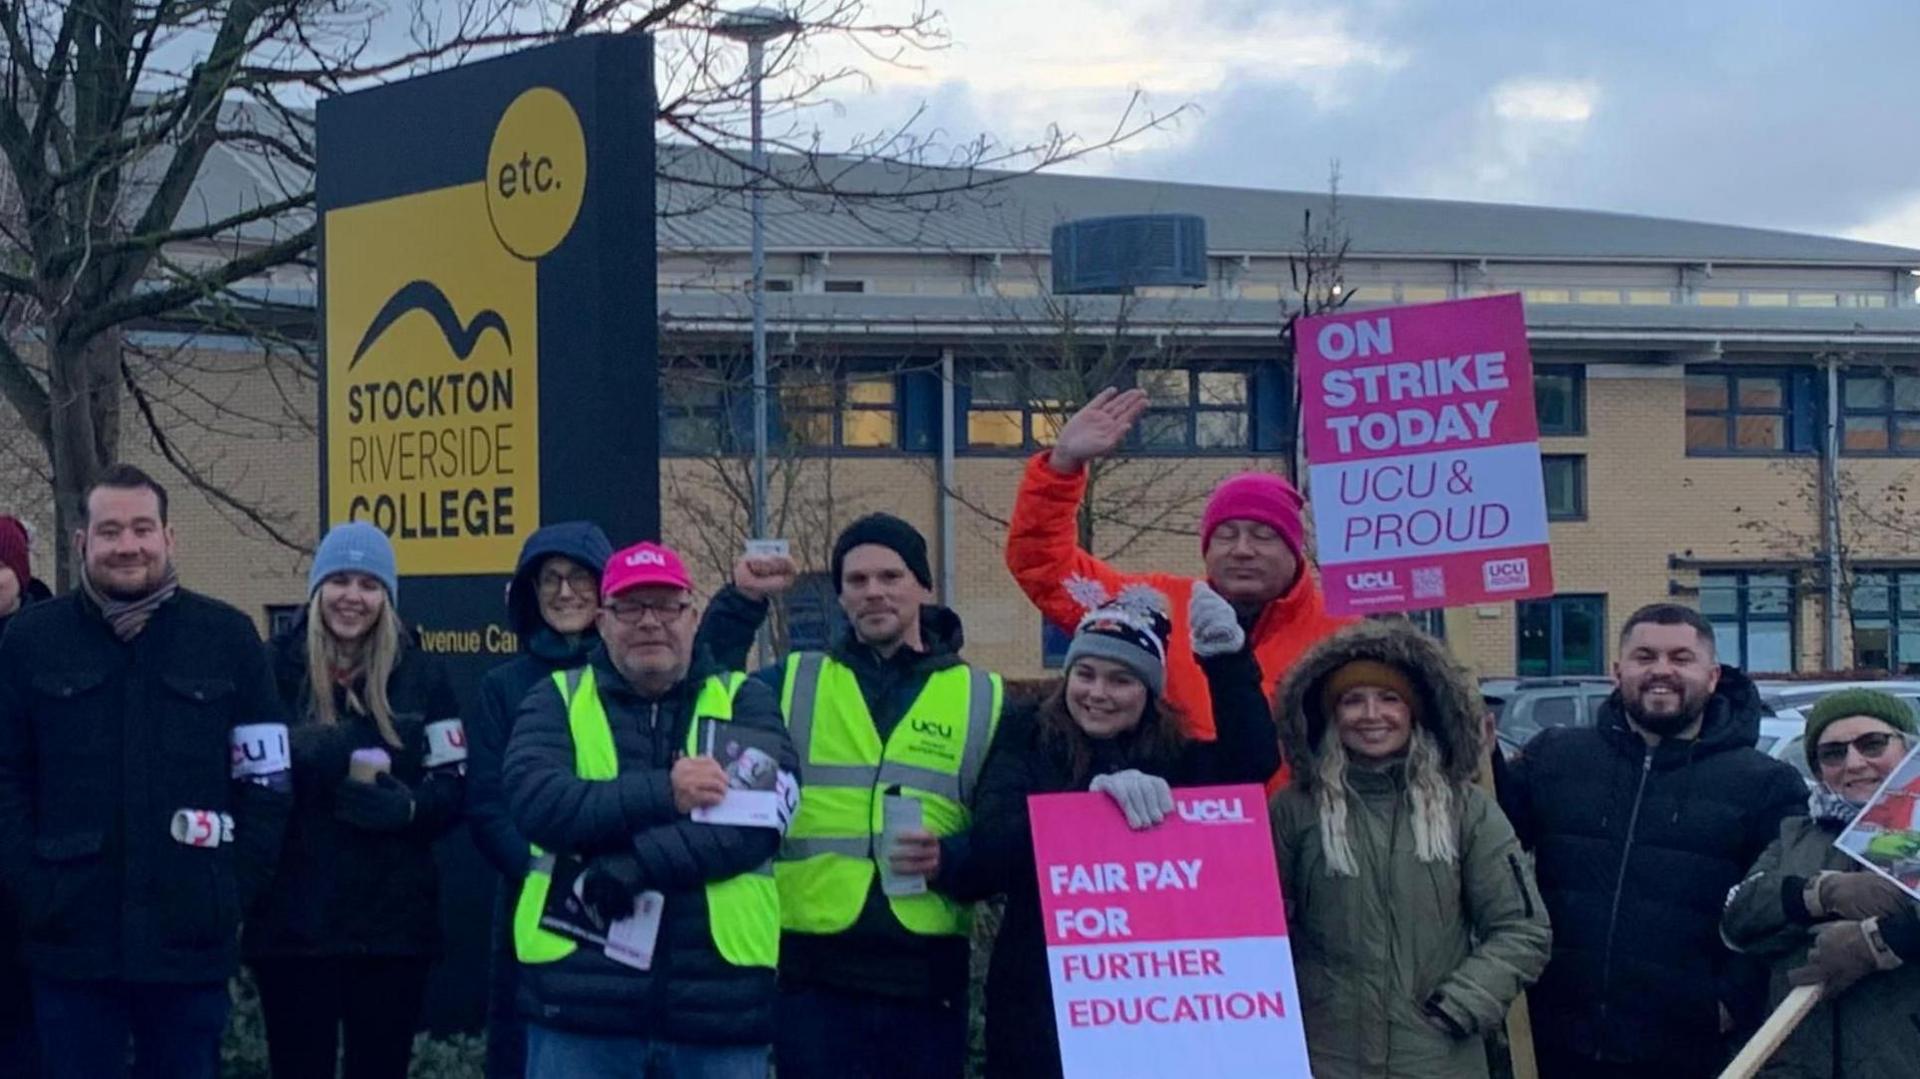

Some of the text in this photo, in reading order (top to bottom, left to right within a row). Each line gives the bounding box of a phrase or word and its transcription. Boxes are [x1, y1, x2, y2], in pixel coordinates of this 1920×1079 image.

[499, 151, 561, 199] etc.
[1317, 317, 1393, 360] ON
[349, 368, 514, 424] STOCKTON
[1322, 351, 1509, 408] STRIKE
[1326, 400, 1499, 453] TODAY
[350, 423, 514, 484] RIVERSIDE
[1340, 459, 1473, 505] UCU &
[349, 486, 515, 540] COLLEGE
[1345, 503, 1510, 552] PROUD
[1489, 562, 1525, 577] UCU
[1050, 859, 1203, 895] FAIR PAY
[1055, 907, 1131, 938] FOR
[1062, 948, 1224, 982] FURTHER
[1068, 991, 1286, 1028] EDUCATION
